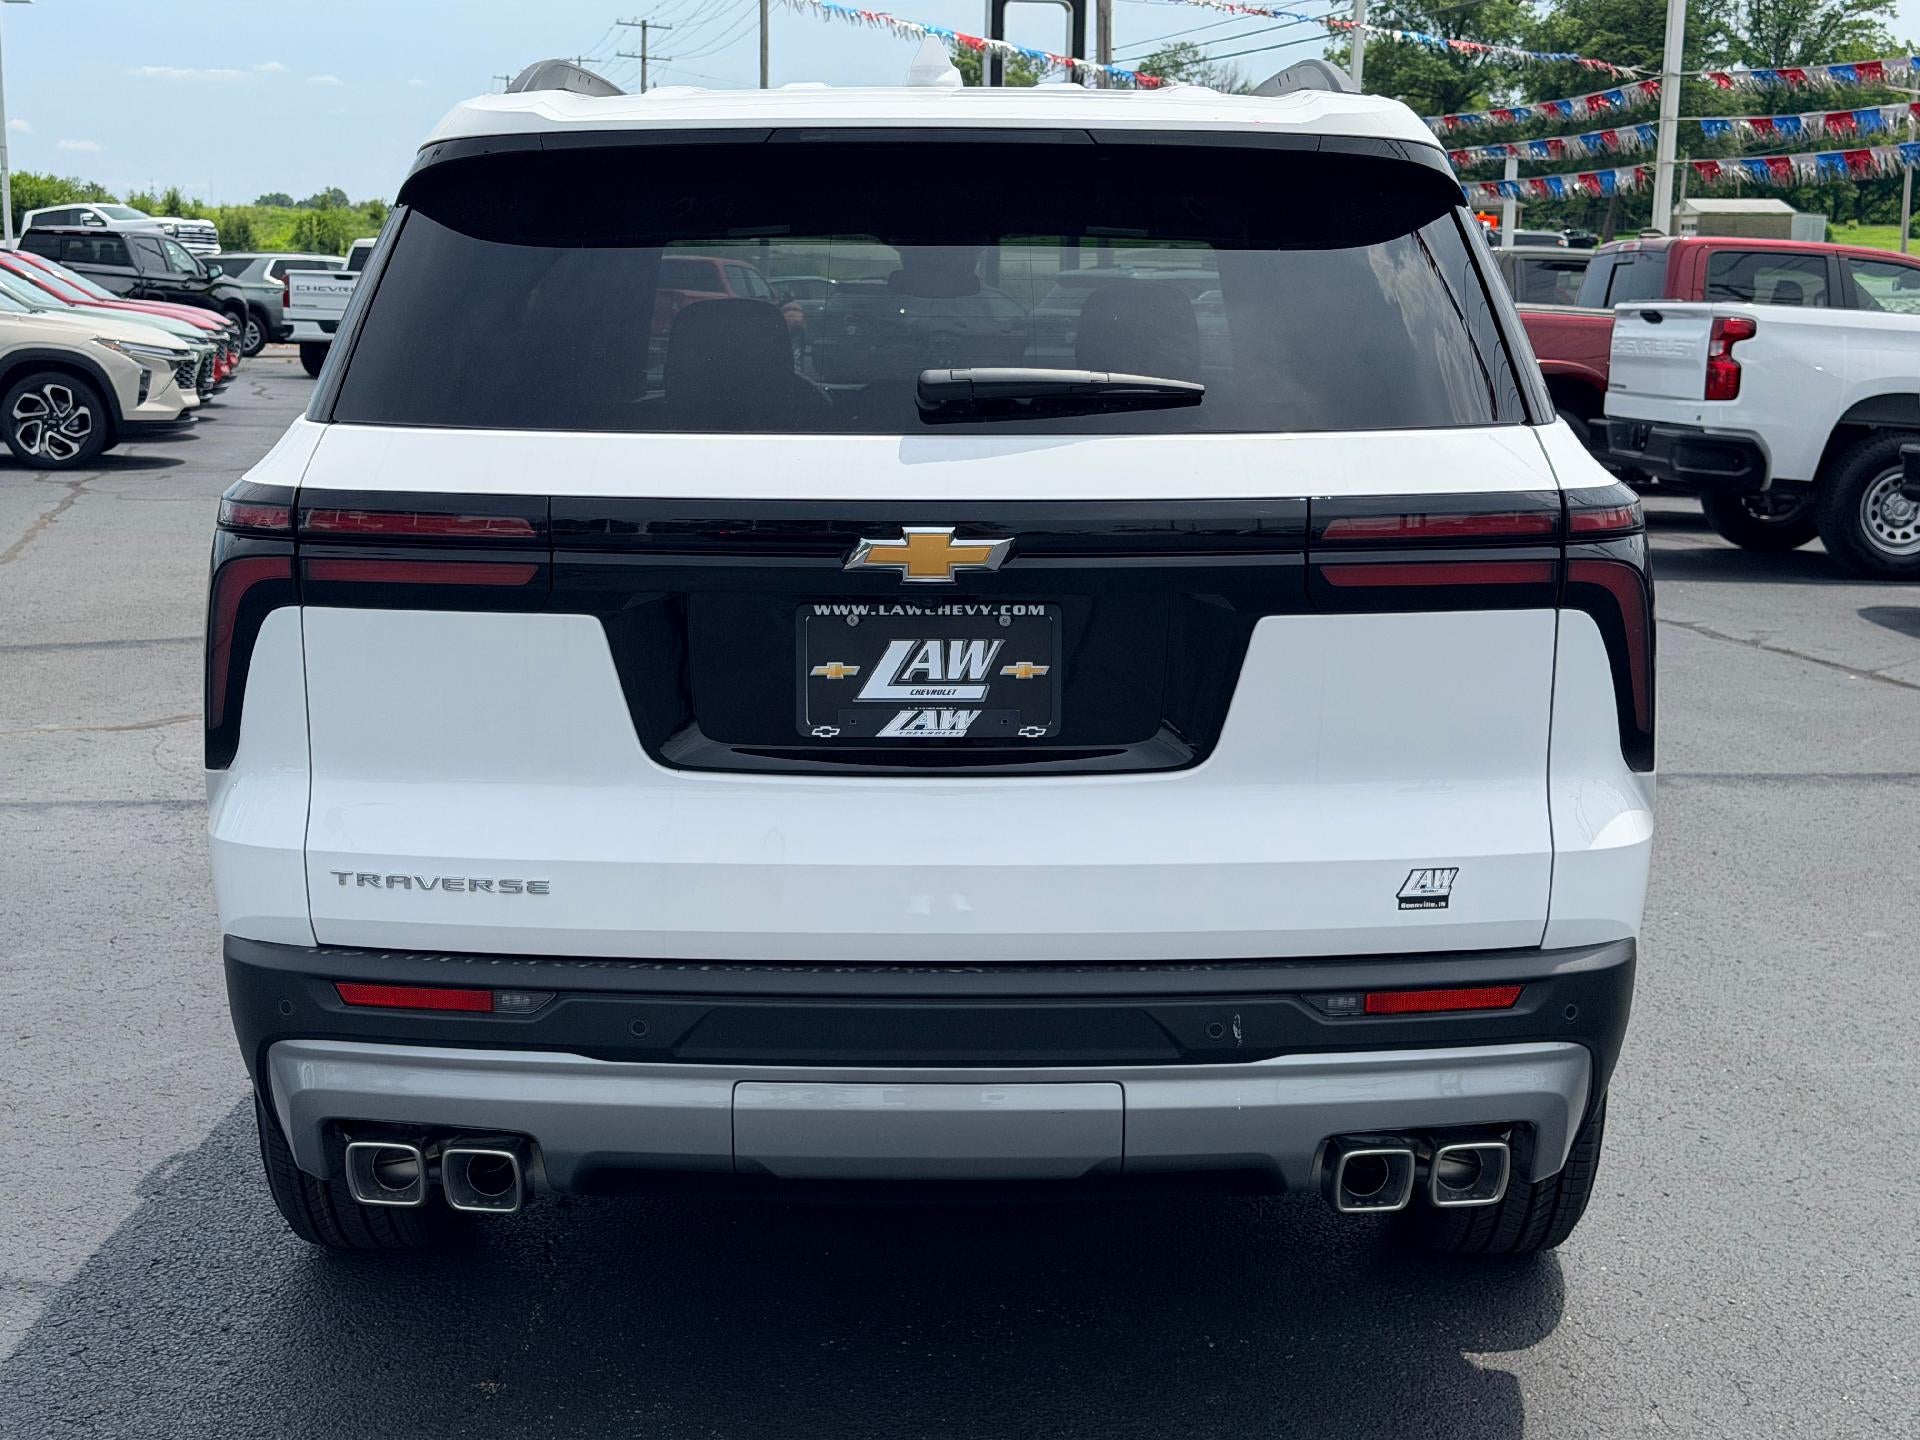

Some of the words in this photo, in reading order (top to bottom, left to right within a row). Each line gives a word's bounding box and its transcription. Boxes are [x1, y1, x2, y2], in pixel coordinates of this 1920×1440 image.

[813, 604, 1045, 616] WWW.LAWCHEVY.COM
[854, 639, 1004, 701] LAW
[909, 688, 957, 696] CHEVROLET
[875, 710, 982, 737] LAW
[329, 871, 550, 894] TRAVERSE
[1397, 867, 1459, 897] LAW
